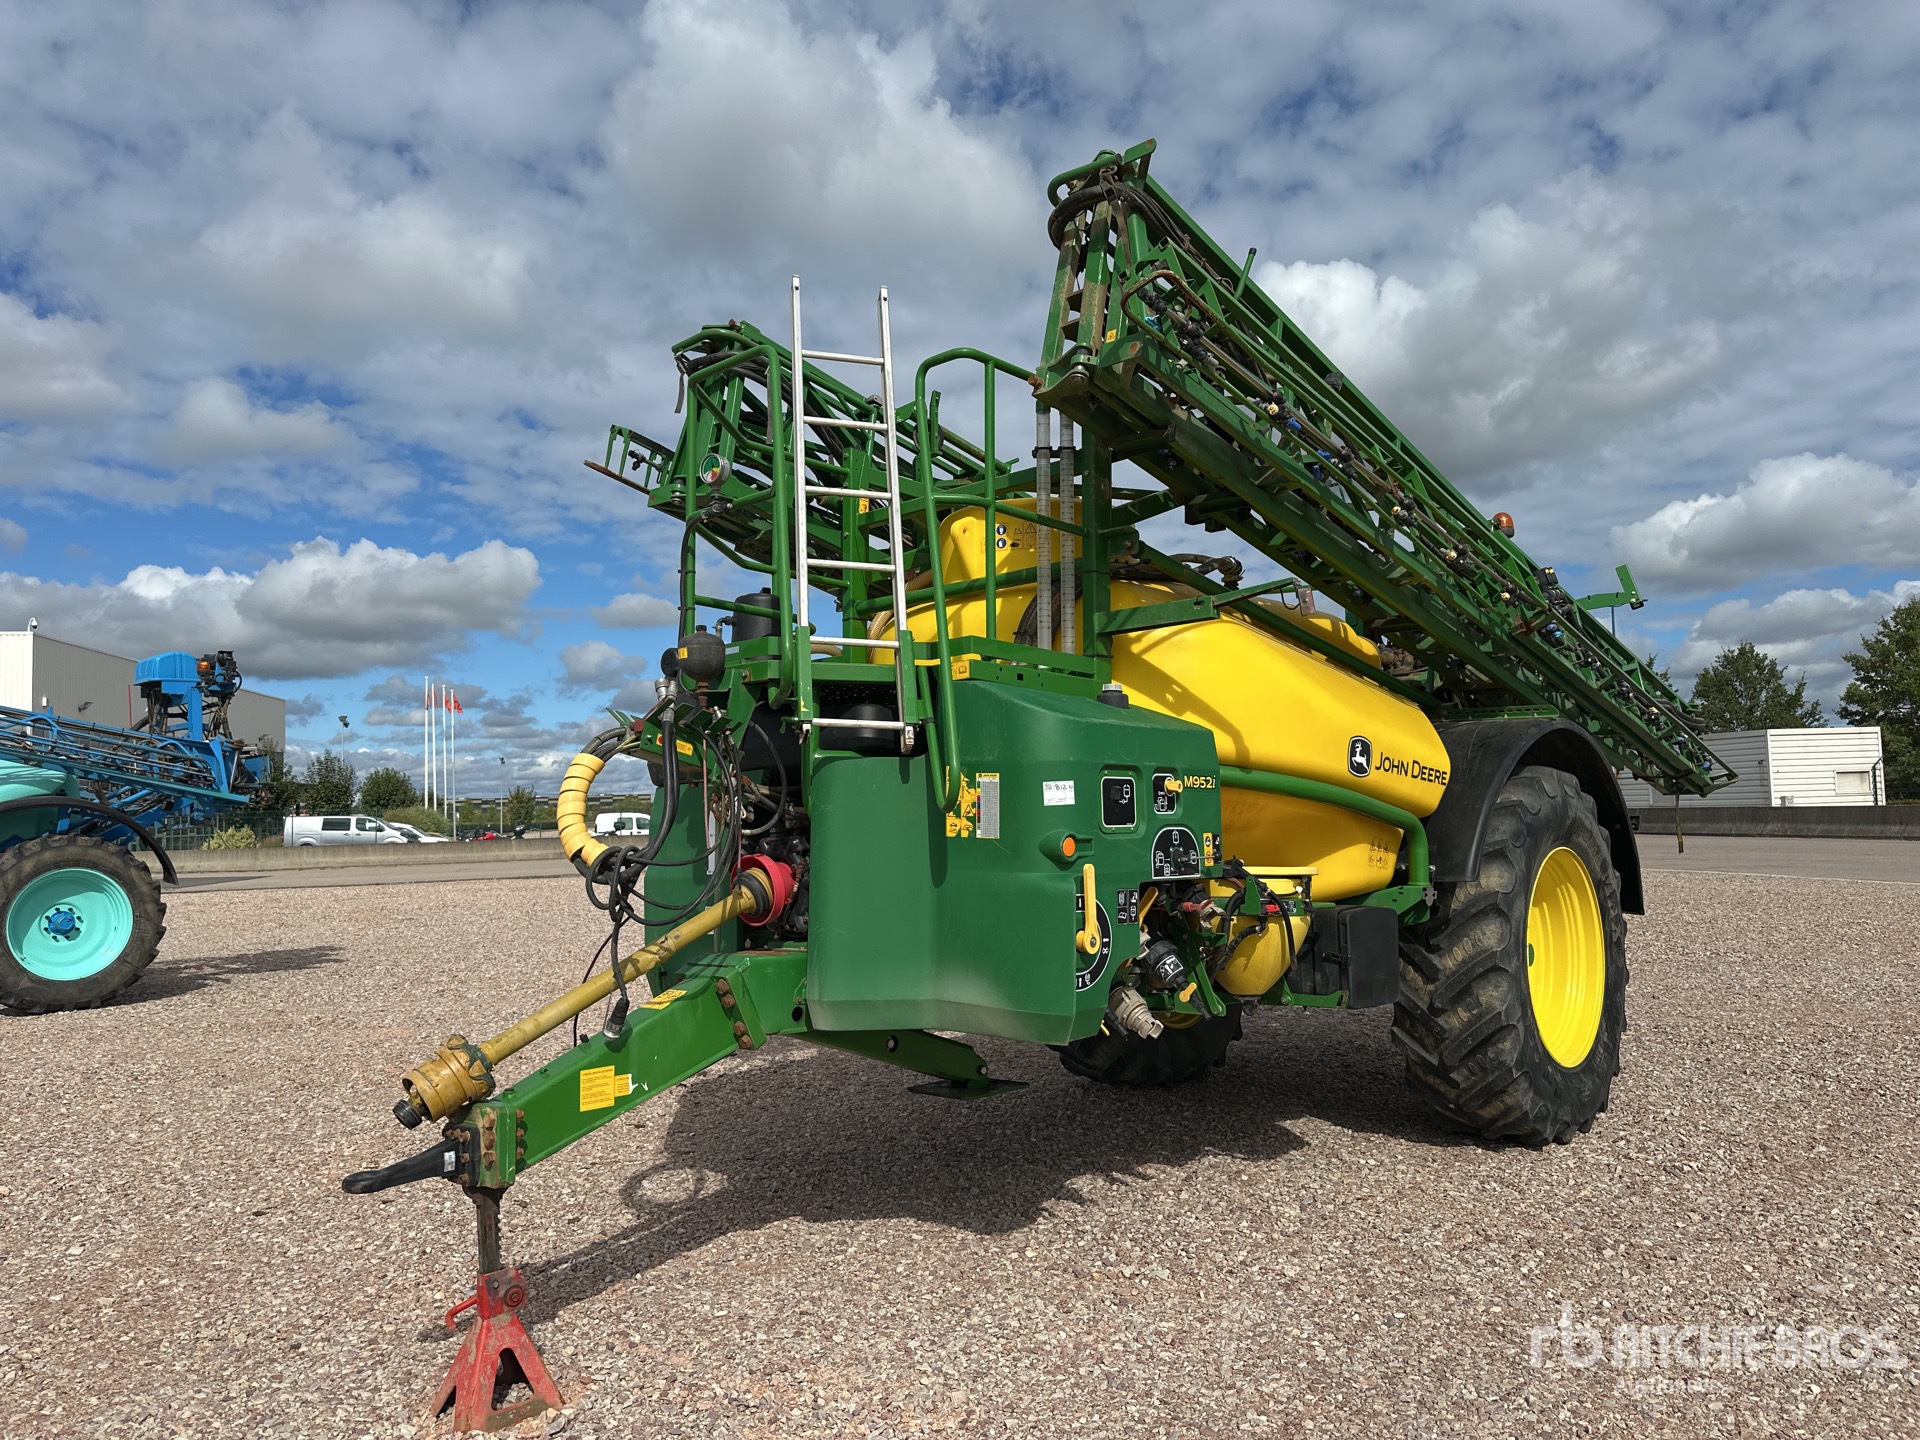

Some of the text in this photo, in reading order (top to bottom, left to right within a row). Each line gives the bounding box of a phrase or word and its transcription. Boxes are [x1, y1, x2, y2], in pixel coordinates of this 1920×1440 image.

[1375, 752, 1448, 786] JOHN DEERE
[1184, 775, 1216, 789] M952i
